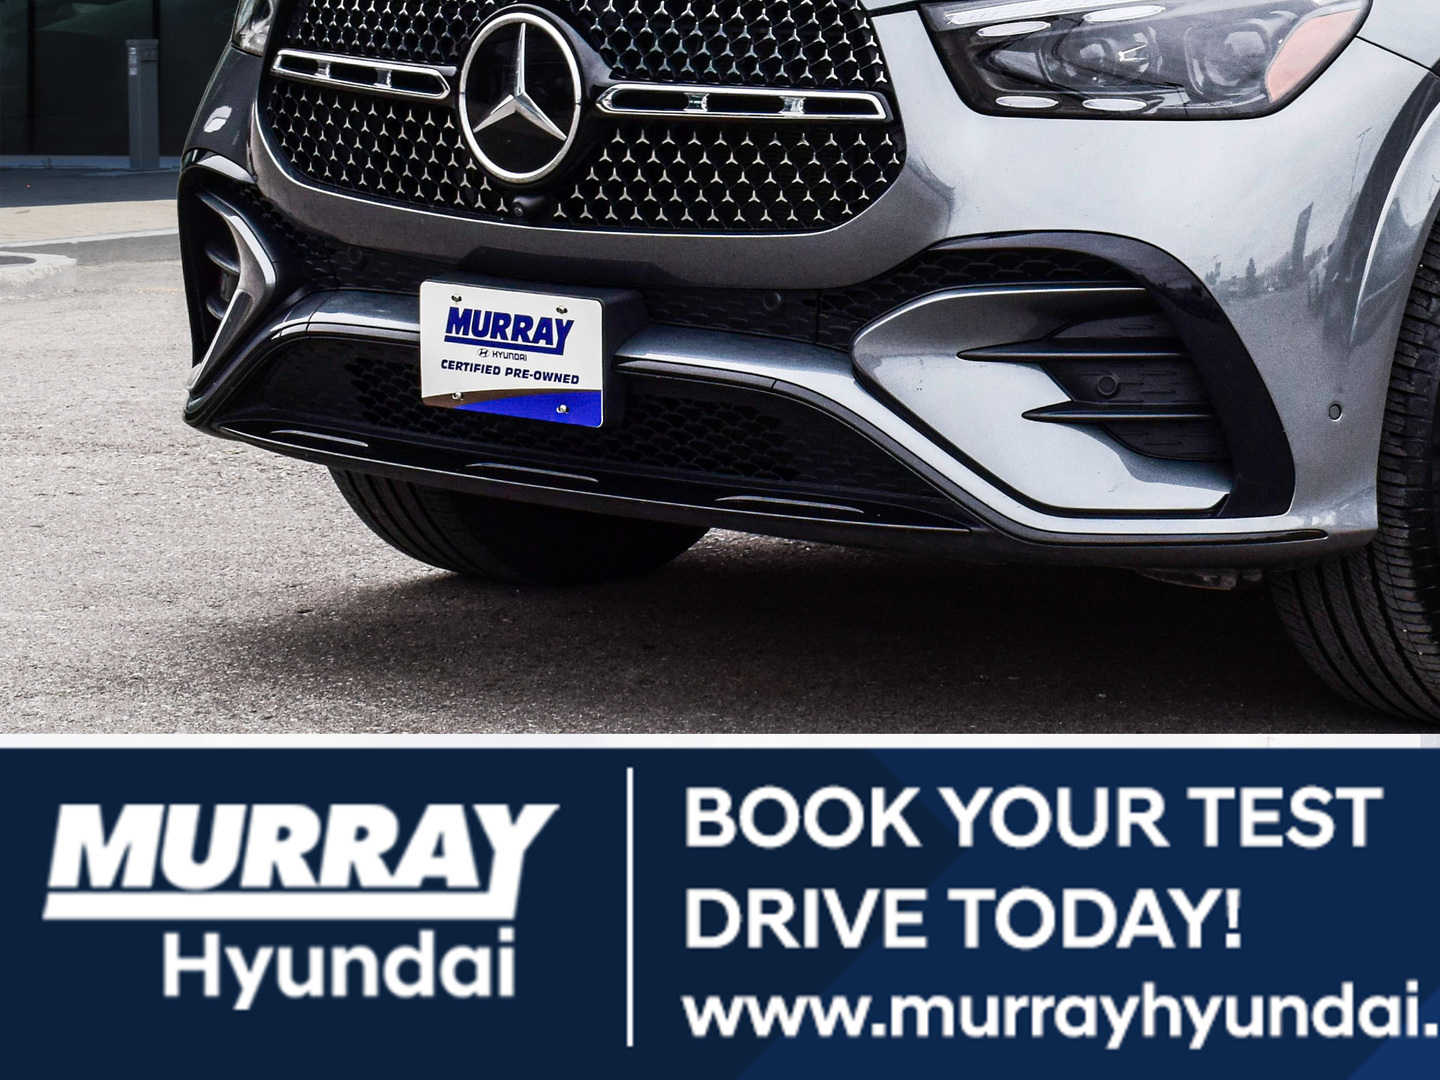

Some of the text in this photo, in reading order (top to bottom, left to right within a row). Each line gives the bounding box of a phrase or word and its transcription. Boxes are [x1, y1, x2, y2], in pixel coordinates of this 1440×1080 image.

[443, 306, 575, 356] MURRAY
[492, 350, 528, 362] HYUNDAI
[440, 359, 580, 385] CERTIFIED PRE-OWNED
